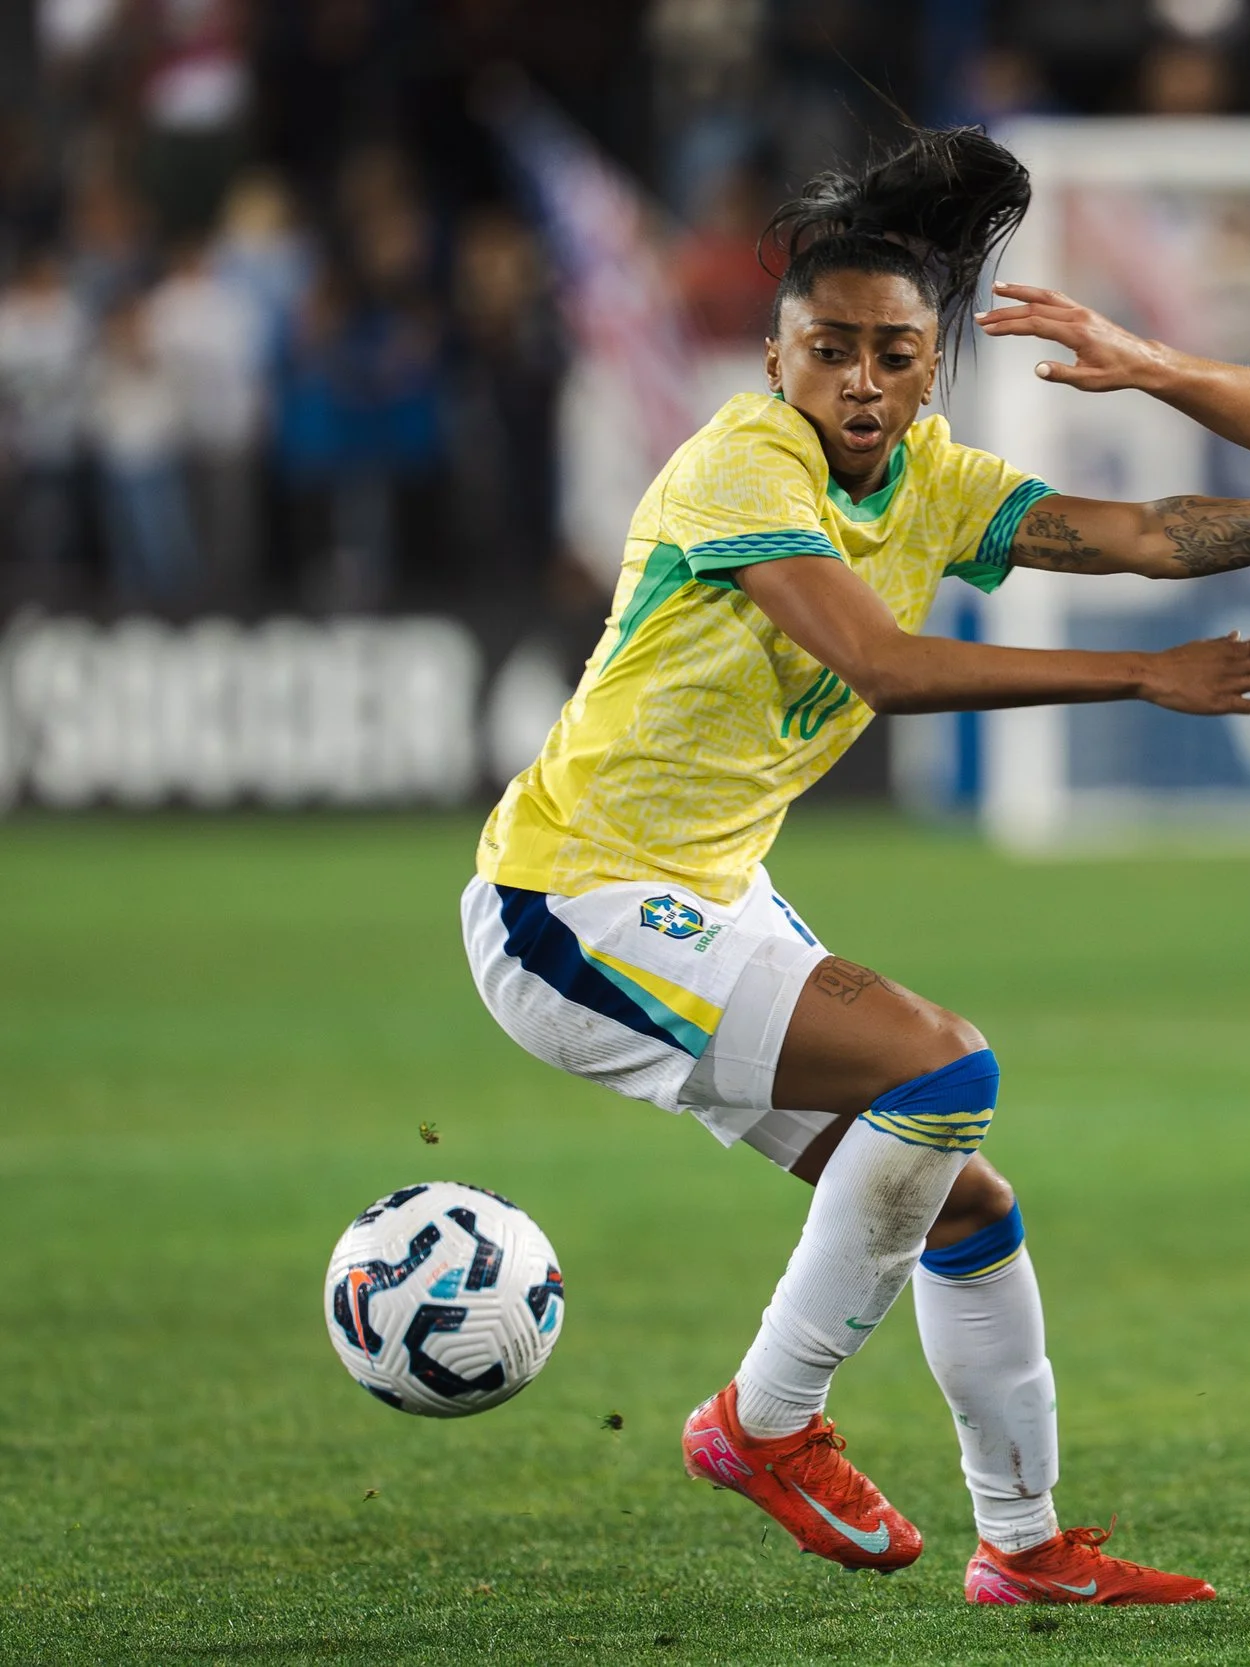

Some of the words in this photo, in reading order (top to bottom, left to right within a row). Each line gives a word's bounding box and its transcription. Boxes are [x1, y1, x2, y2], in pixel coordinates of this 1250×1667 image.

[16, 617, 480, 803] SOCCER
[780, 667, 851, 740] 10
[694, 924, 724, 952] BRAS
